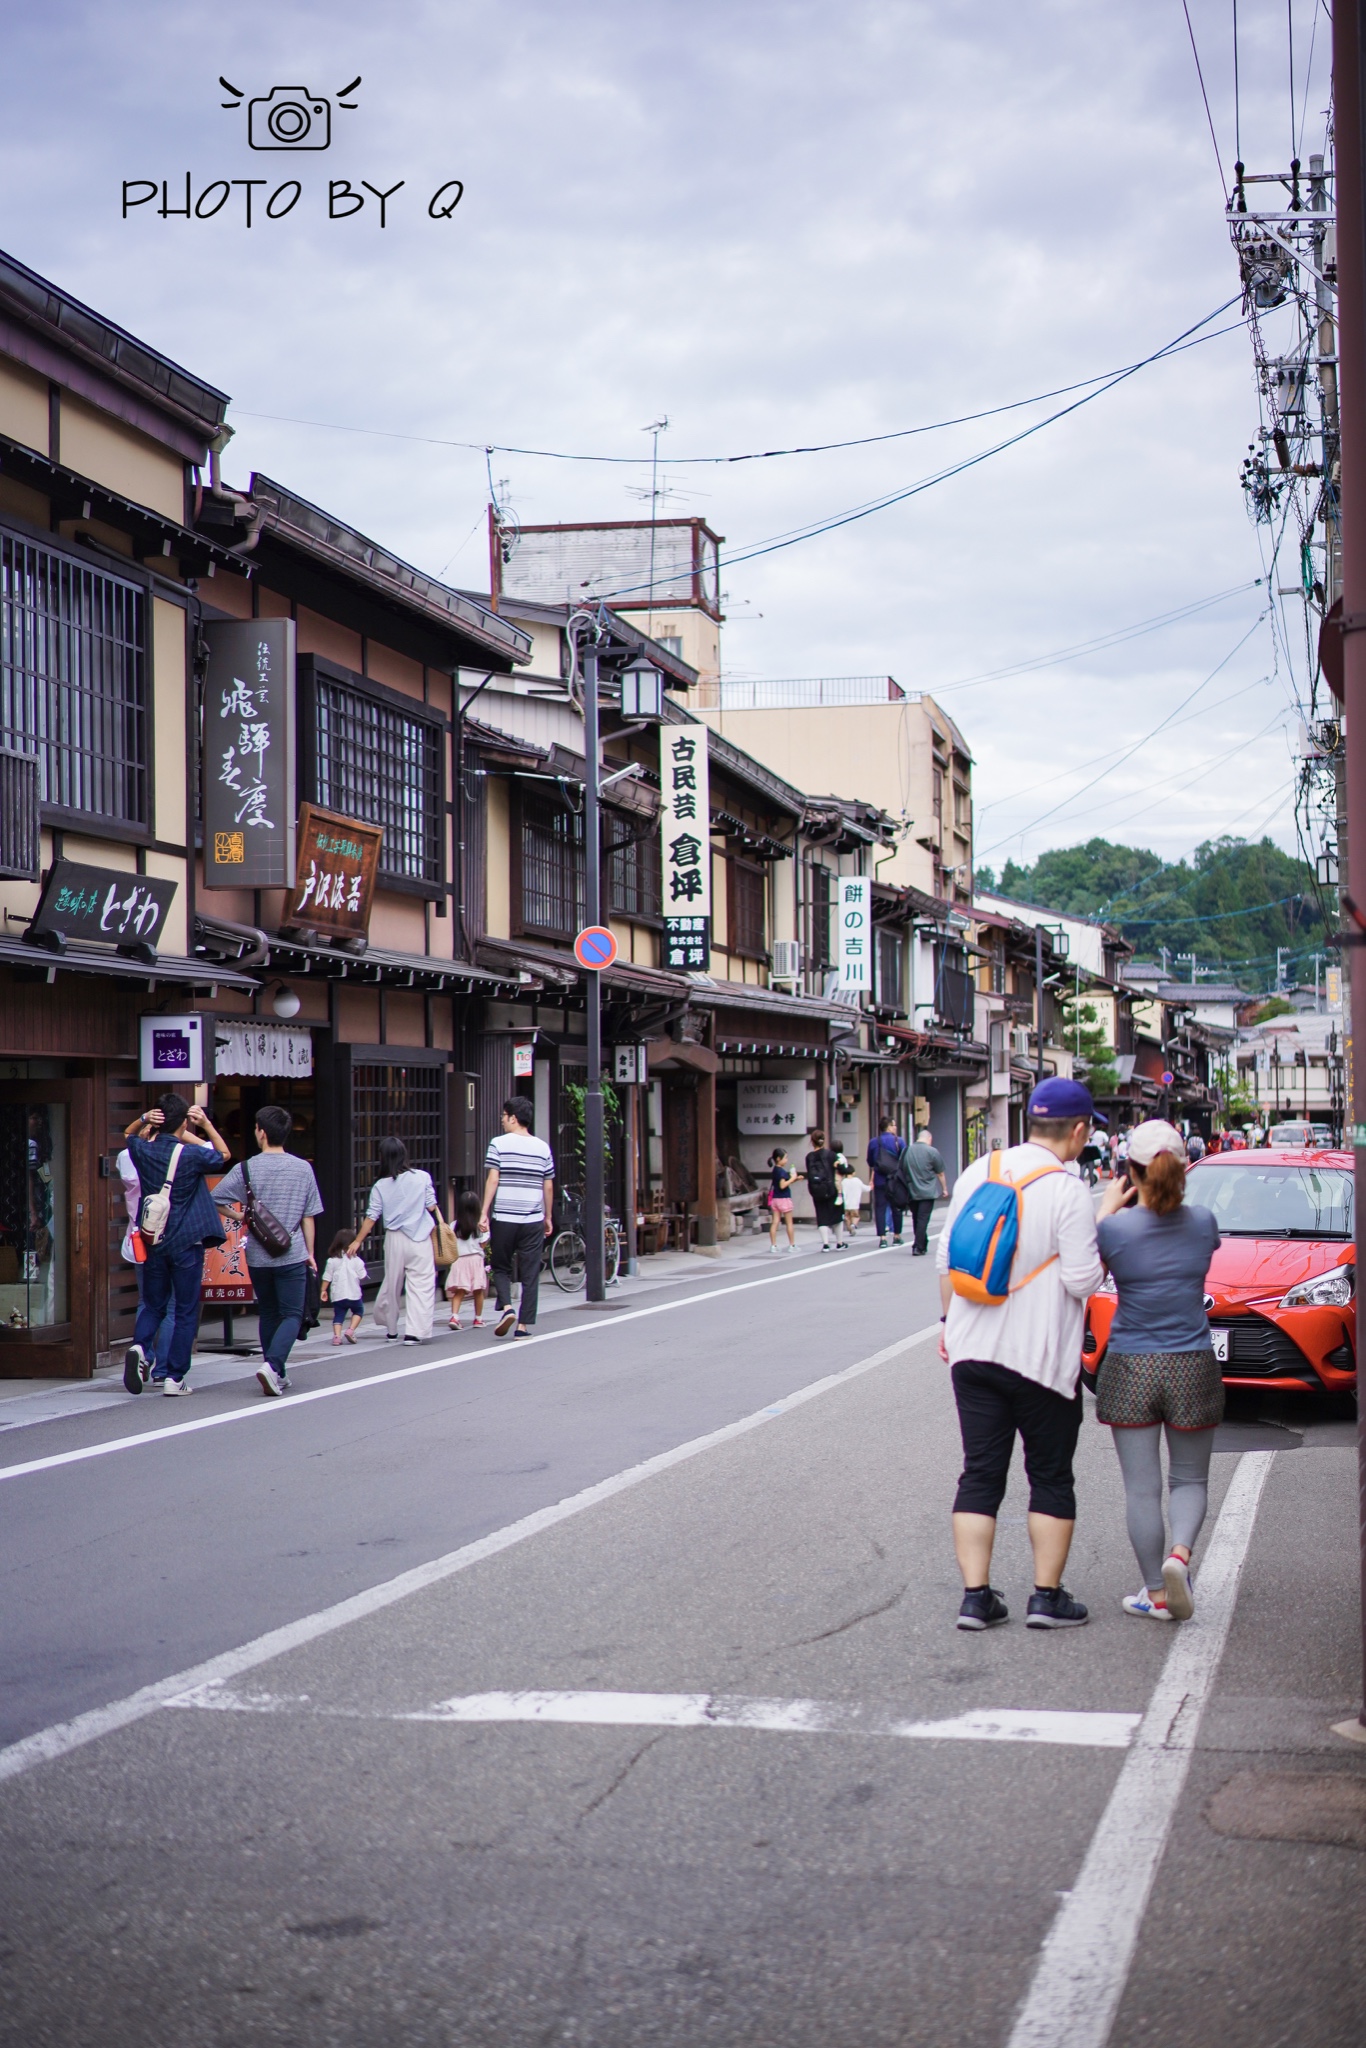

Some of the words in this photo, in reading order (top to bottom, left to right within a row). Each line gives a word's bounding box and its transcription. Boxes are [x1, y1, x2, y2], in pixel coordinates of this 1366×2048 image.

[671, 736, 697, 820] 古民芸
[669, 832, 703, 902] 倉坪
[100, 883, 159, 935] とざわ
[667, 917, 705, 931] 不動産
[844, 884, 863, 981] 餅の吉川
[670, 936, 703, 945] 株式会社
[669, 948, 704, 965] 倉坪
[157, 1048, 187, 1062] とざわ
[742, 1085, 788, 1094] ANTIQUE
[205, 1287, 245, 1298] 直売の店
